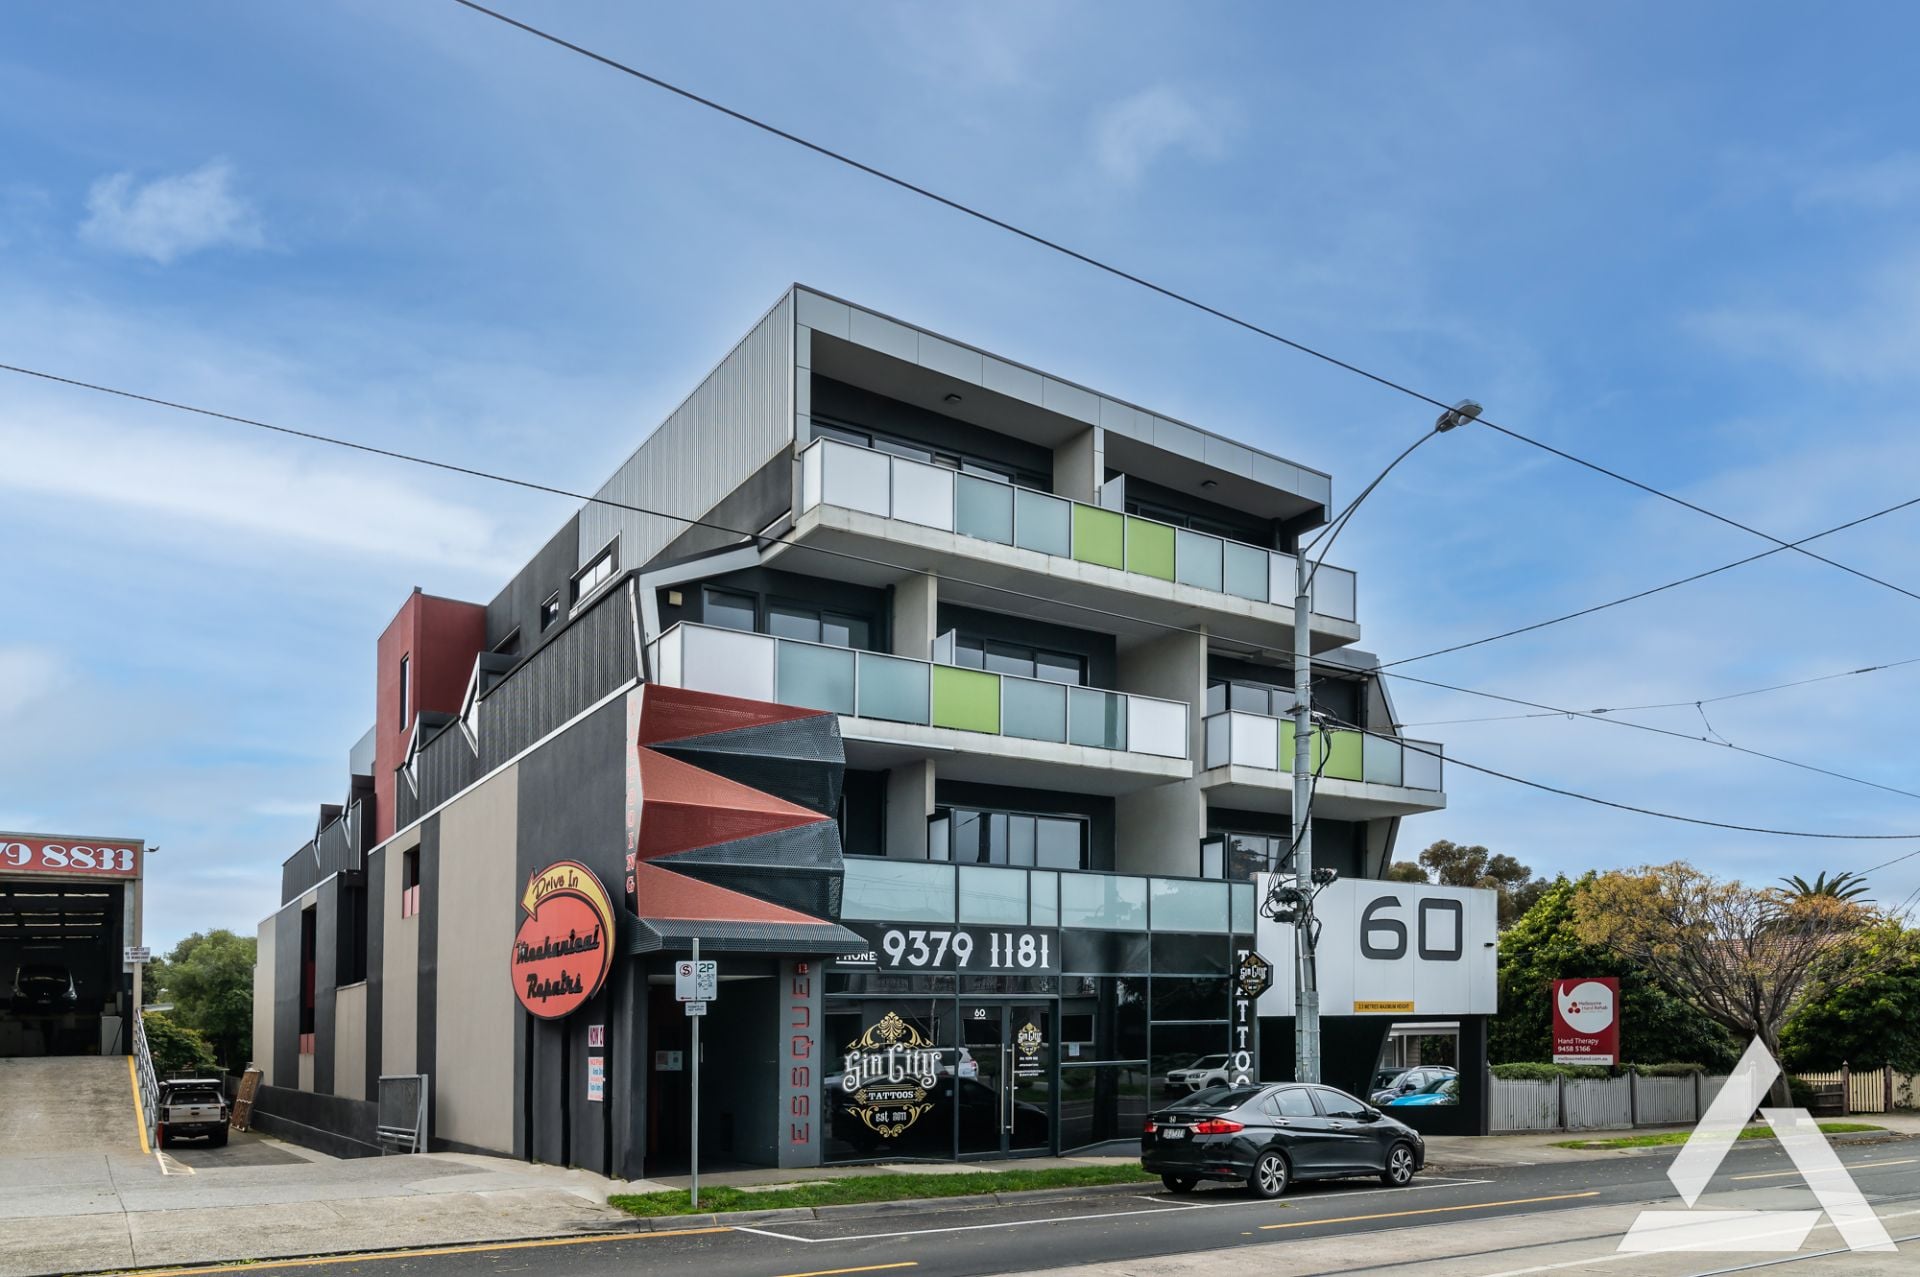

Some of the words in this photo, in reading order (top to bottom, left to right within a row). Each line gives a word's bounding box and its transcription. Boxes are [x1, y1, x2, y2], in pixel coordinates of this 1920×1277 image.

[42, 844, 134, 871] 8833
[532, 876, 565, 900] Drive
[568, 869, 579, 889] In
[1360, 895, 1463, 961] 60
[516, 924, 602, 965] Mechanical
[883, 930, 973, 966] 9379
[990, 933, 1050, 968] 1181
[699, 963, 715, 973] 2P
[526, 970, 583, 1003] Repairs
[974, 1008, 986, 1017] 60
[1575, 1038, 1600, 1046] Therapy
[843, 1051, 883, 1092] Sin
[887, 1043, 942, 1088] City
[868, 1091, 914, 1100] TATTOOS
